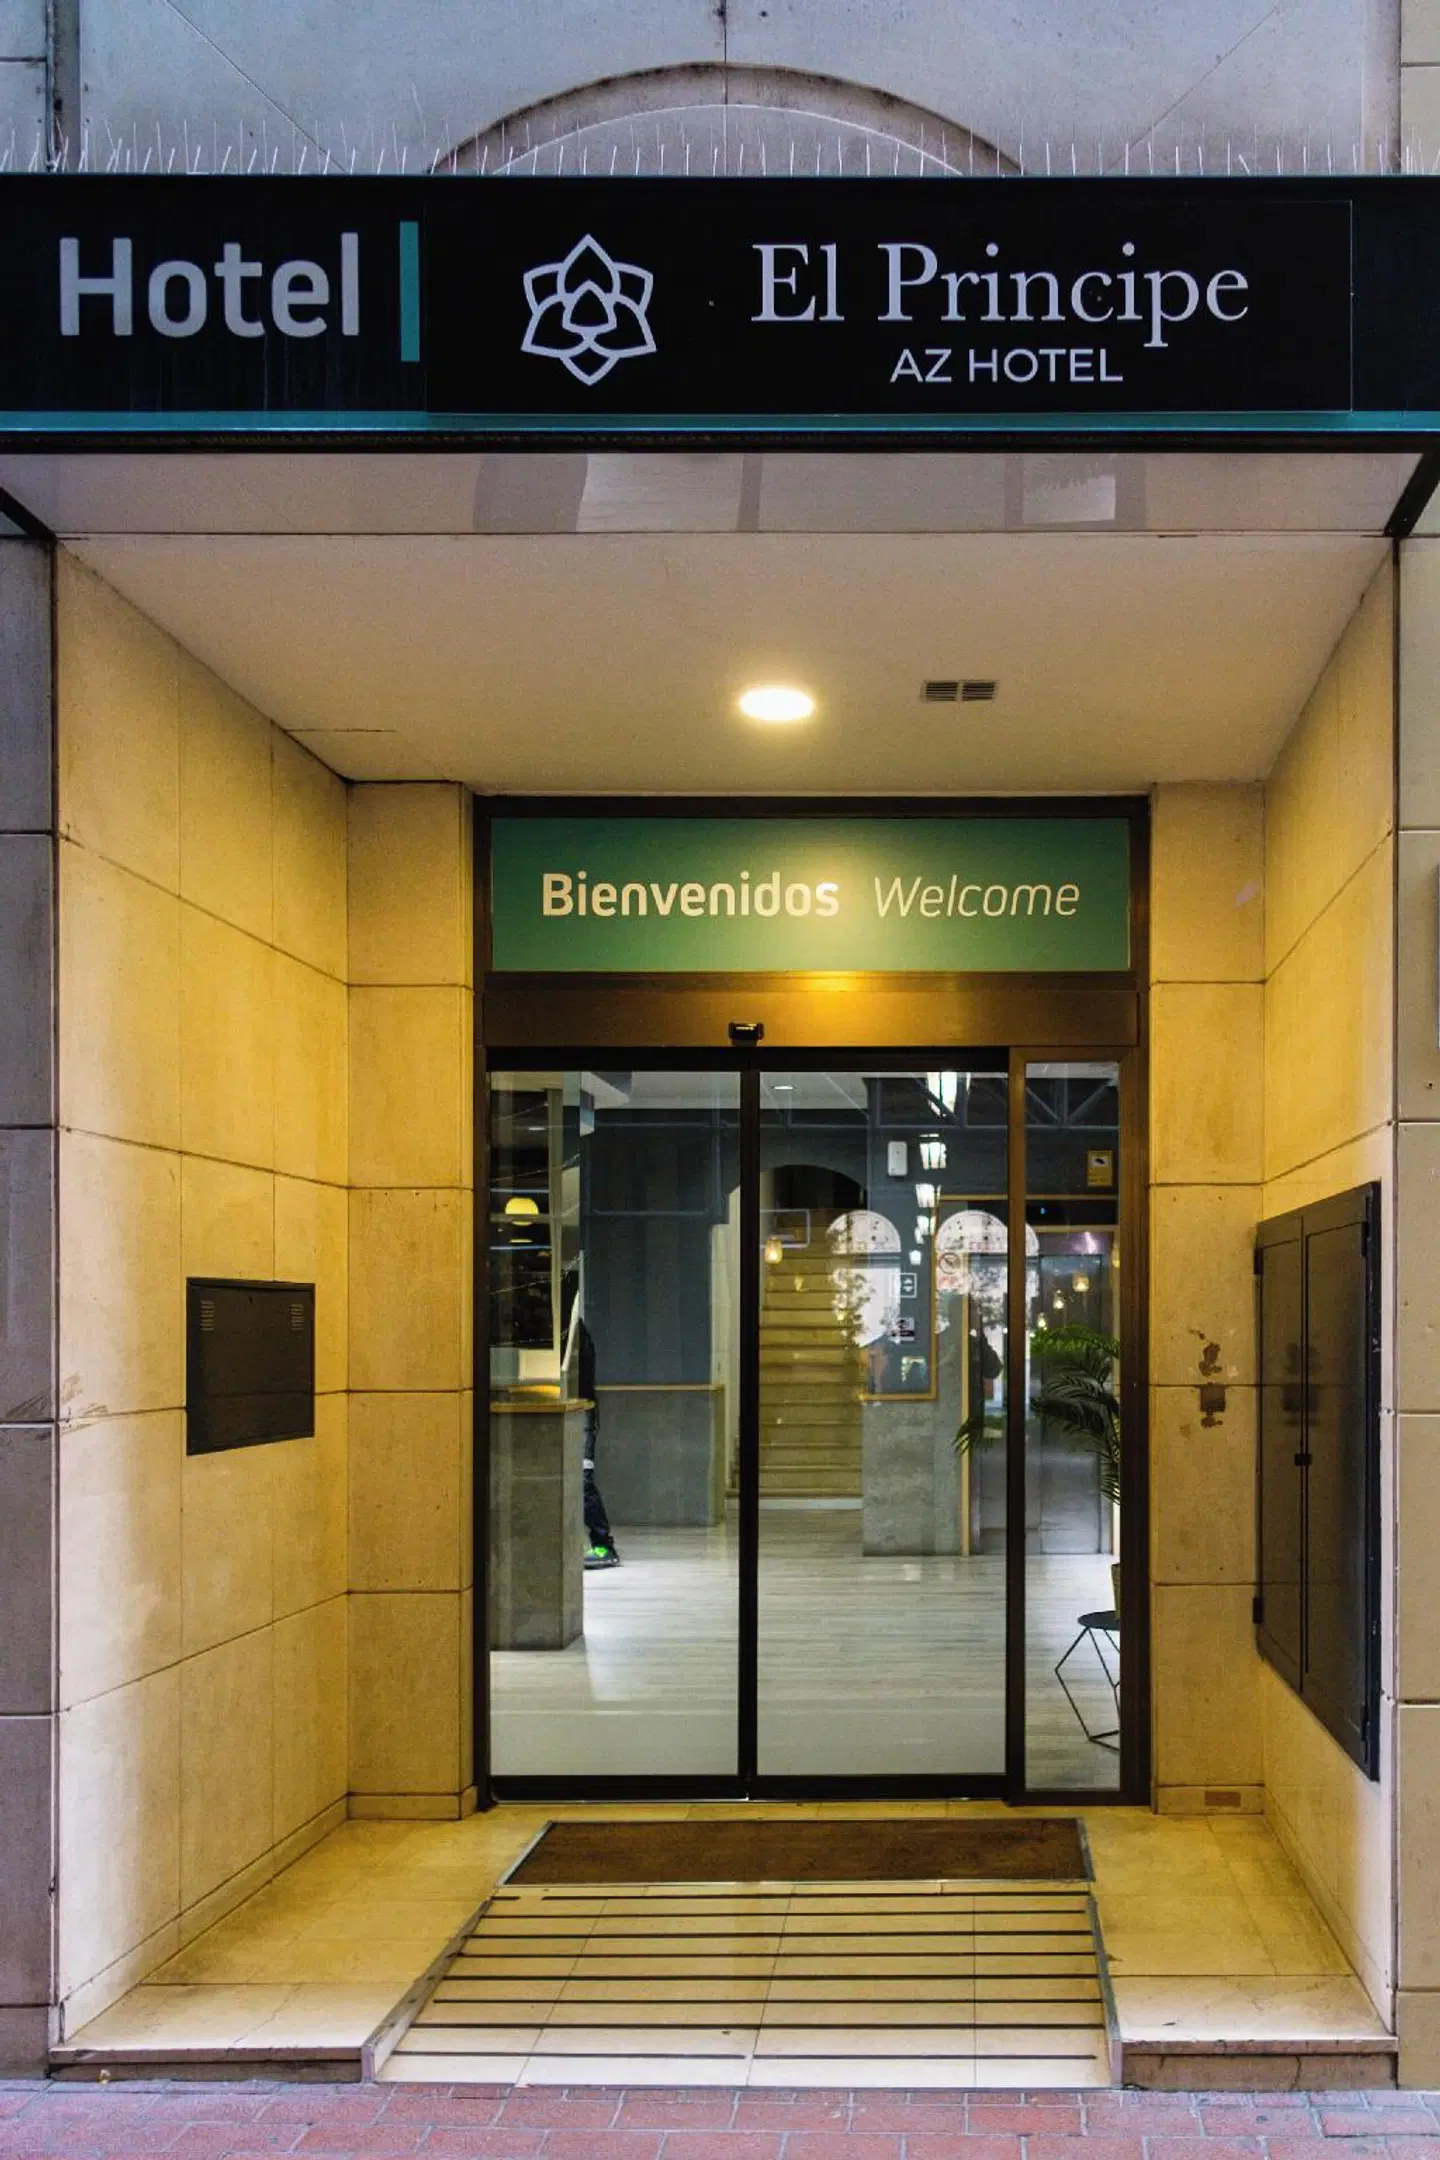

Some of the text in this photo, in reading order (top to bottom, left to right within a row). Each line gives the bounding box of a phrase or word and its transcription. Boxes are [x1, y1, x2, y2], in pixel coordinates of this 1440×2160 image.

[59, 232, 360, 337] Hotel
[751, 242, 1250, 348] El Principe
[889, 348, 1124, 383] AZ HOTEL
[541, 870, 1080, 918] Bienvenidos Welcome
